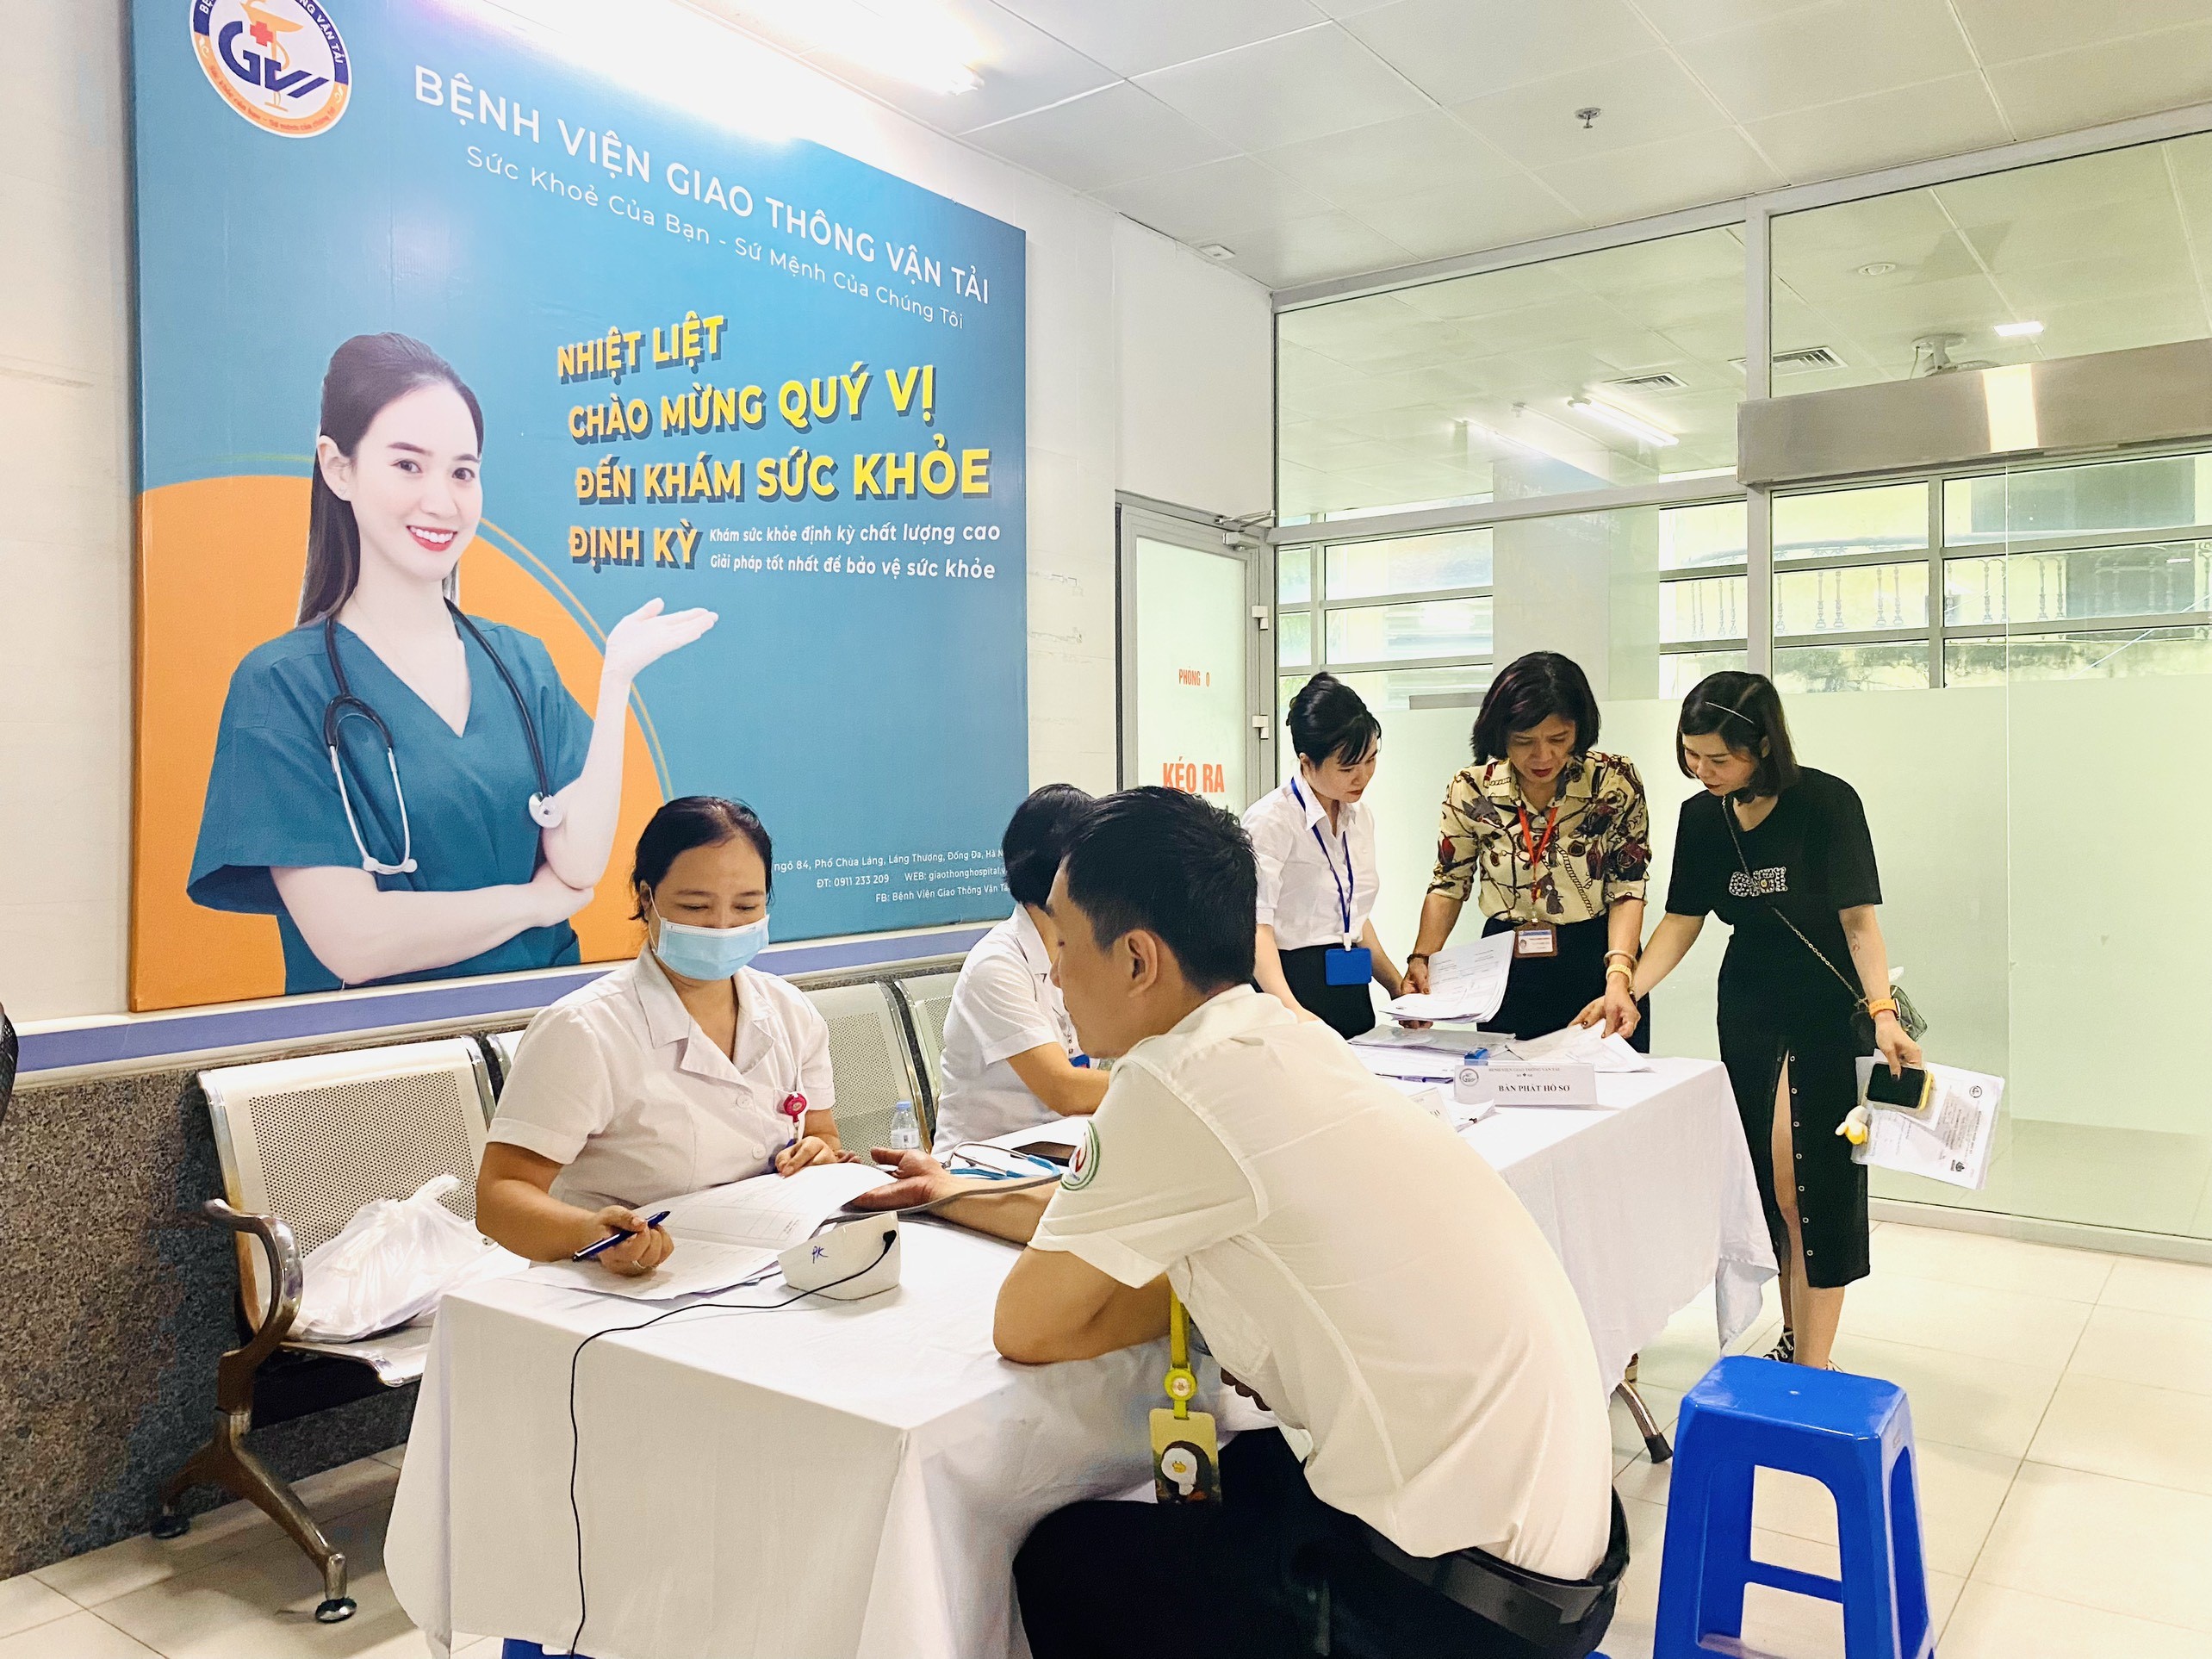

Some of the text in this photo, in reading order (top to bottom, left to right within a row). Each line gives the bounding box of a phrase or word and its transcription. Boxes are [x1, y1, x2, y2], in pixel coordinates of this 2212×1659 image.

[415, 65, 989, 304] BỆNH VIỆN GIAO THÔNG VẬN TẢI
[467, 146, 519, 180] Sức
[531, 166, 600, 207] Khoẻ
[608, 195, 655, 227] Của
[666, 213, 709, 244] Bạn
[735, 237, 761, 261] Sứ
[770, 248, 826, 283] Mệnh
[833, 270, 868, 298] Của
[875, 286, 934, 323] Chúng
[939, 306, 963, 329] Tôi
[557, 310, 726, 382] NHIỆT LIỆT
[568, 360, 935, 442] CHÀO MỪNG QUÝ VỊ
[575, 432, 991, 502] ĐẾN KHÁM SỨC KHỎE
[569, 518, 700, 569] ĐỊNH KỲ
[709, 521, 1001, 545] Khám sức khỏe định kỳ chất lượng cao
[710, 552, 996, 580] Giải pháp tốt nhất để bảo vệ sức khỏe
[1163, 756, 1225, 793] KÉO RA
[796, 860, 812, 871] 84,
[814, 856, 834, 869] Phố
[836, 856, 860, 867] Chùa
[948, 848, 970, 861] Đống
[971, 849, 985, 860] Đa,
[985, 848, 997, 858] Hà
[816, 878, 832, 889] ĐT:
[833, 876, 853, 888] 0911
[854, 875, 872, 886] 233
[872, 873, 890, 885] 209
[904, 870, 927, 882] WEB:
[875, 892, 891, 903] FB:
[892, 890, 915, 904] Bệnh
[916, 887, 935, 901] Viện
[937, 886, 956, 898] Giao
[957, 885, 982, 897] Thông
[983, 883, 998, 895] Vận
[1518, 1084, 1543, 1092] PHÁT
